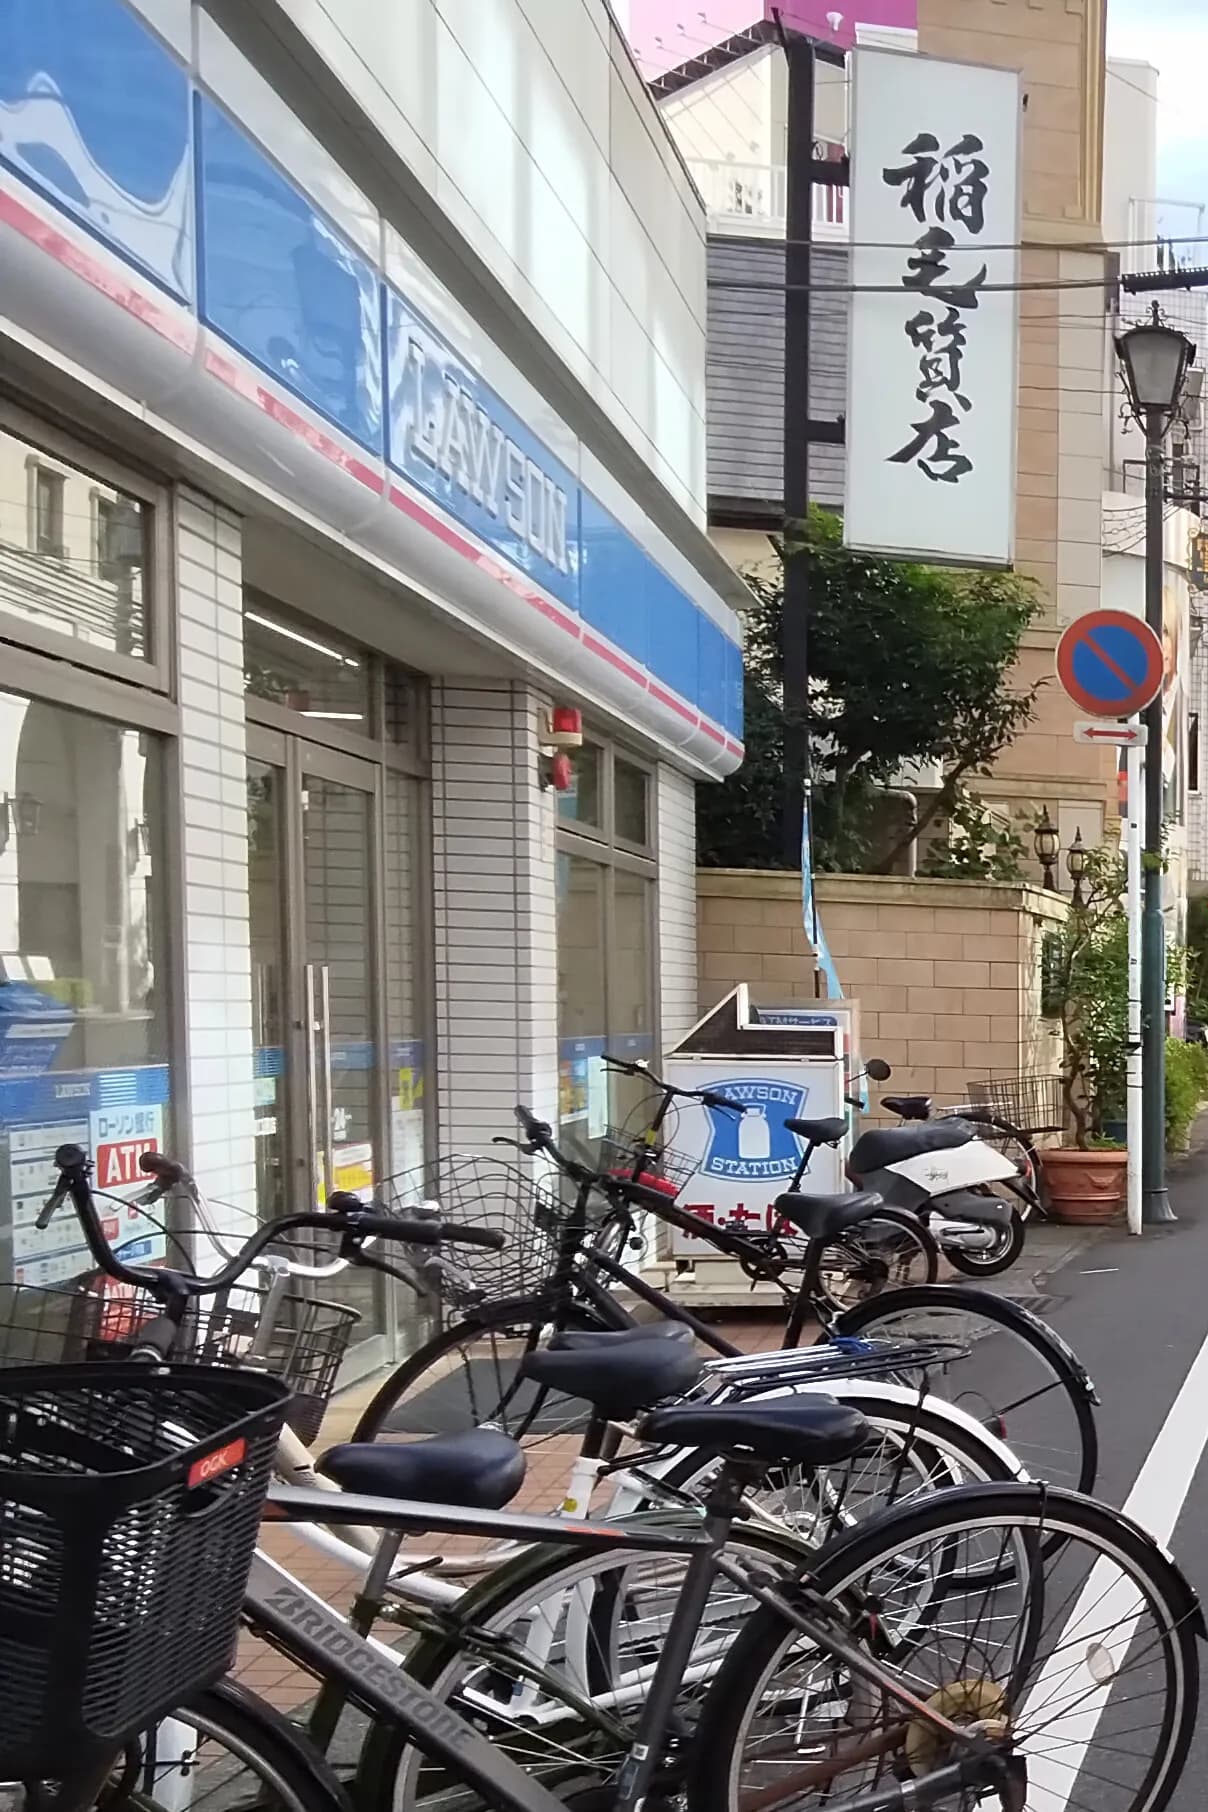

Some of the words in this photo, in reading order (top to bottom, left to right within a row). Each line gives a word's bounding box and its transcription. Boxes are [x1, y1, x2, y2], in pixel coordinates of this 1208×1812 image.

[883, 132, 990, 484] 稲毛質店
[408, 337, 569, 577] LAWSON
[99, 1112, 154, 1138] ローソン銀行
[710, 1156, 799, 1176] STATION
[264, 1585, 478, 1748] BRIDGESTONE
